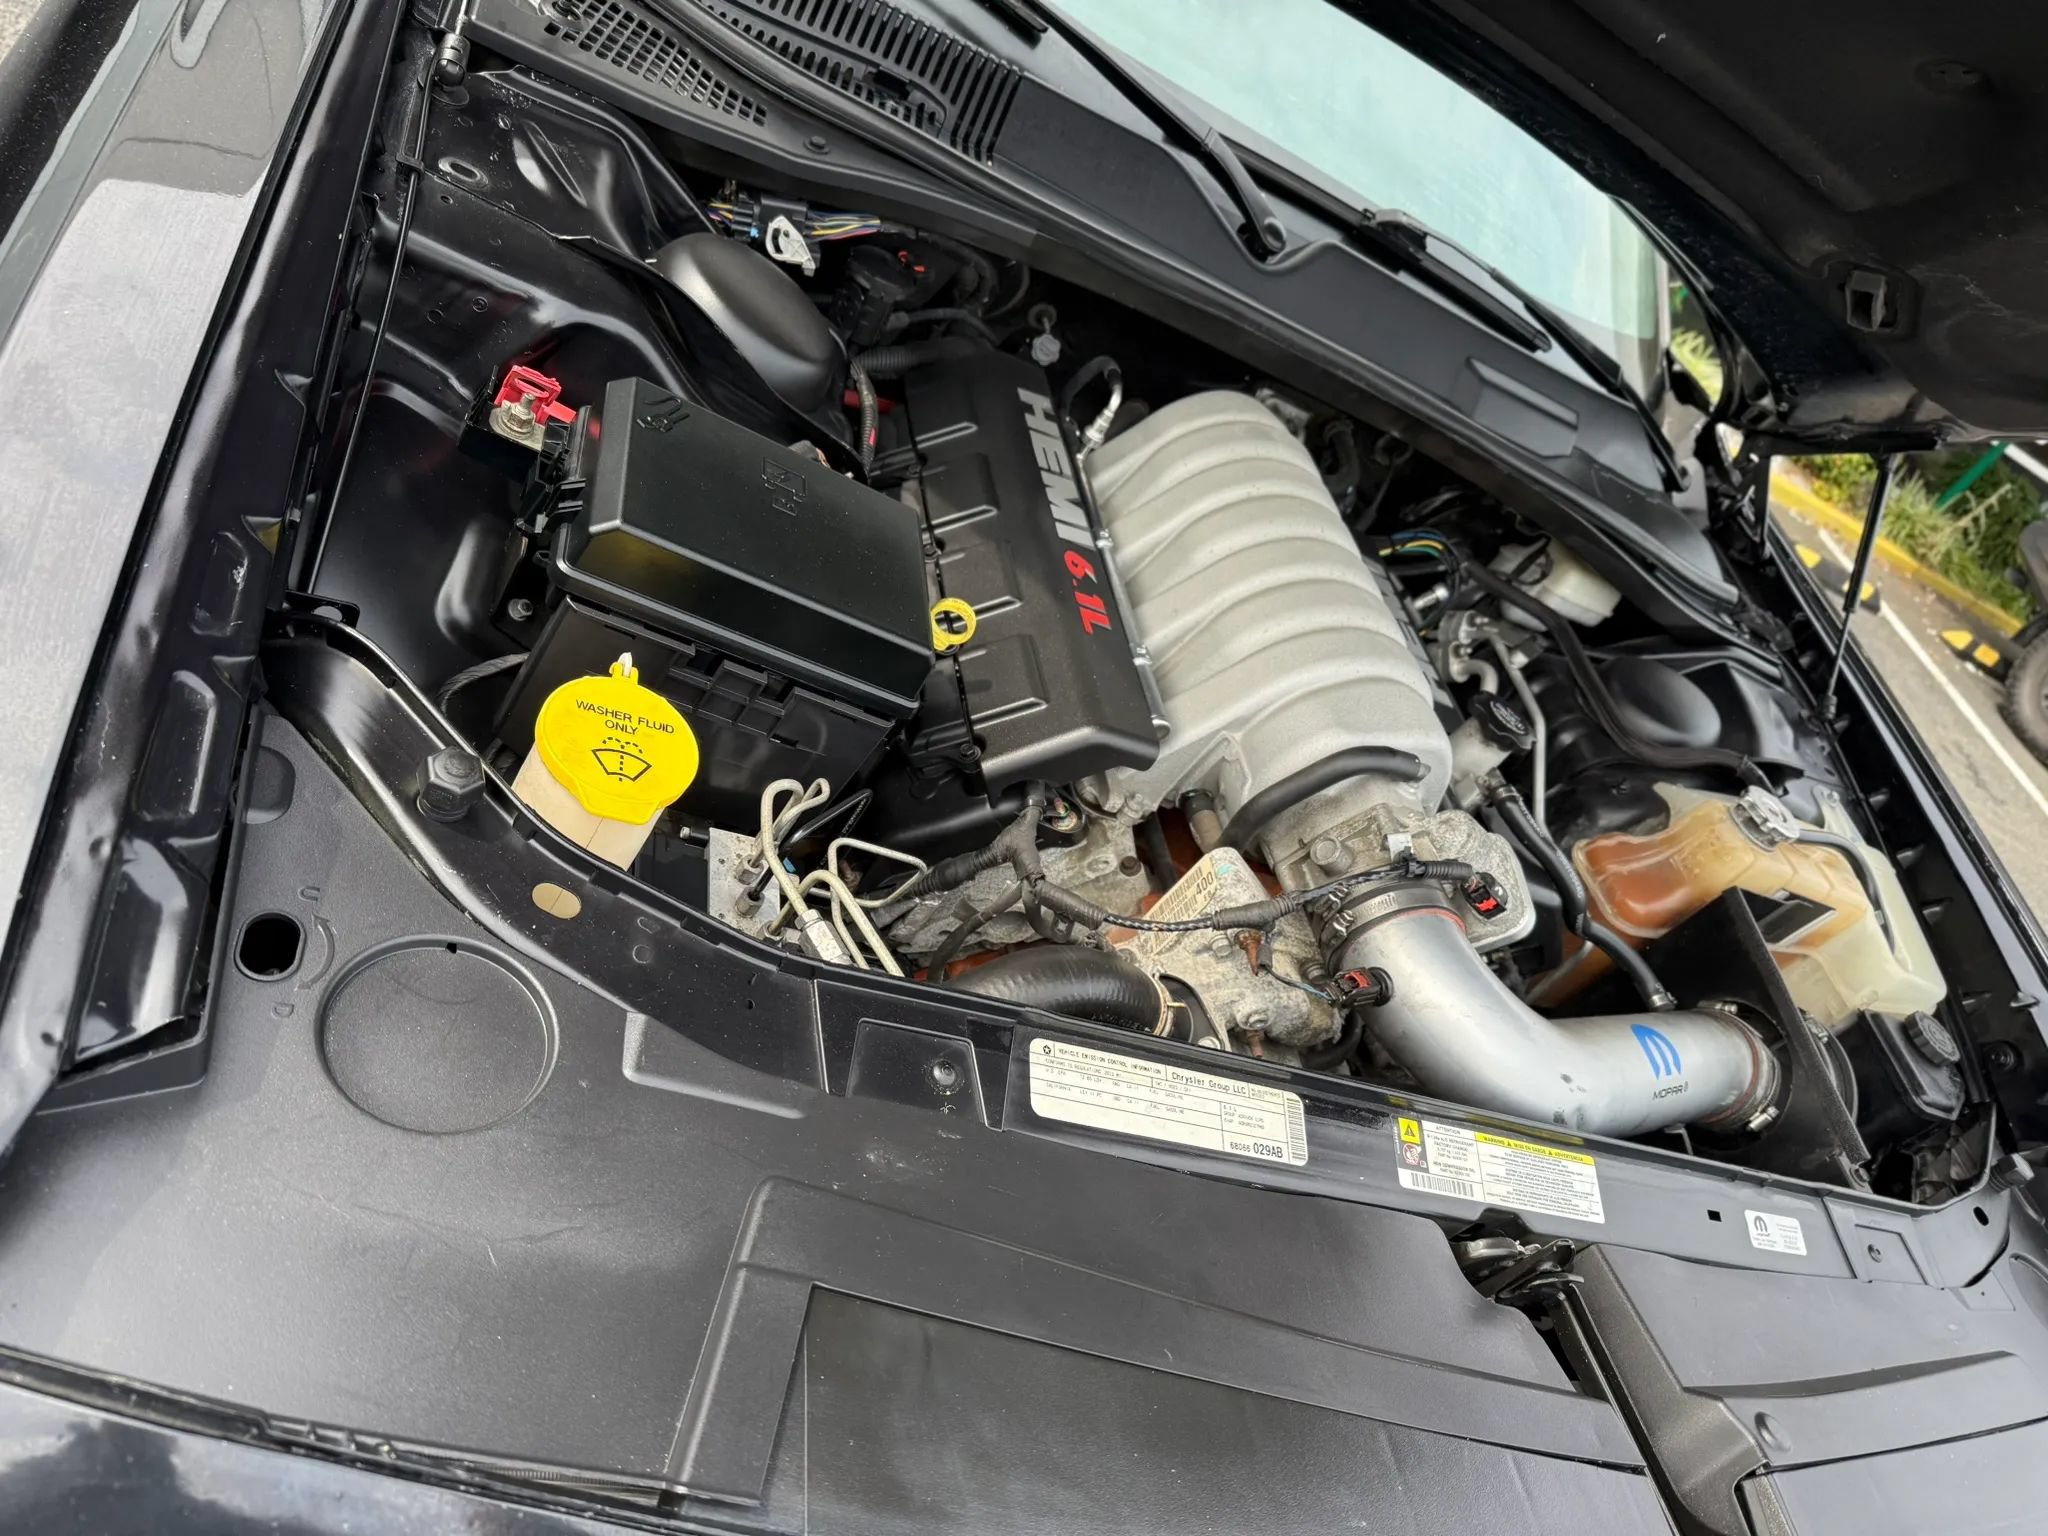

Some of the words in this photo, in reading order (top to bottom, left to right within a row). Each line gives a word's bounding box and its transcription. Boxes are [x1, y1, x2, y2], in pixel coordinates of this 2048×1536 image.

[1017, 387, 1096, 551] HEMI
[1064, 550, 1112, 635] 6.1L
[576, 699, 633, 723] WASHER
[638, 716, 674, 734] FLUID
[605, 719, 638, 735] ONLY
[1196, 872, 1214, 895] 400
[1059, 1048, 1079, 1058] VEHICLE
[1082, 1052, 1105, 1063] EMISSION
[1107, 1057, 1128, 1068] CONTROL
[1131, 1063, 1161, 1075] INFORMATION
[1172, 1072, 1205, 1086] Chrysler
[1209, 1080, 1230, 1093] Group
[1233, 1085, 1246, 1095] LLC
[1253, 1142, 1283, 1159] 029AB
